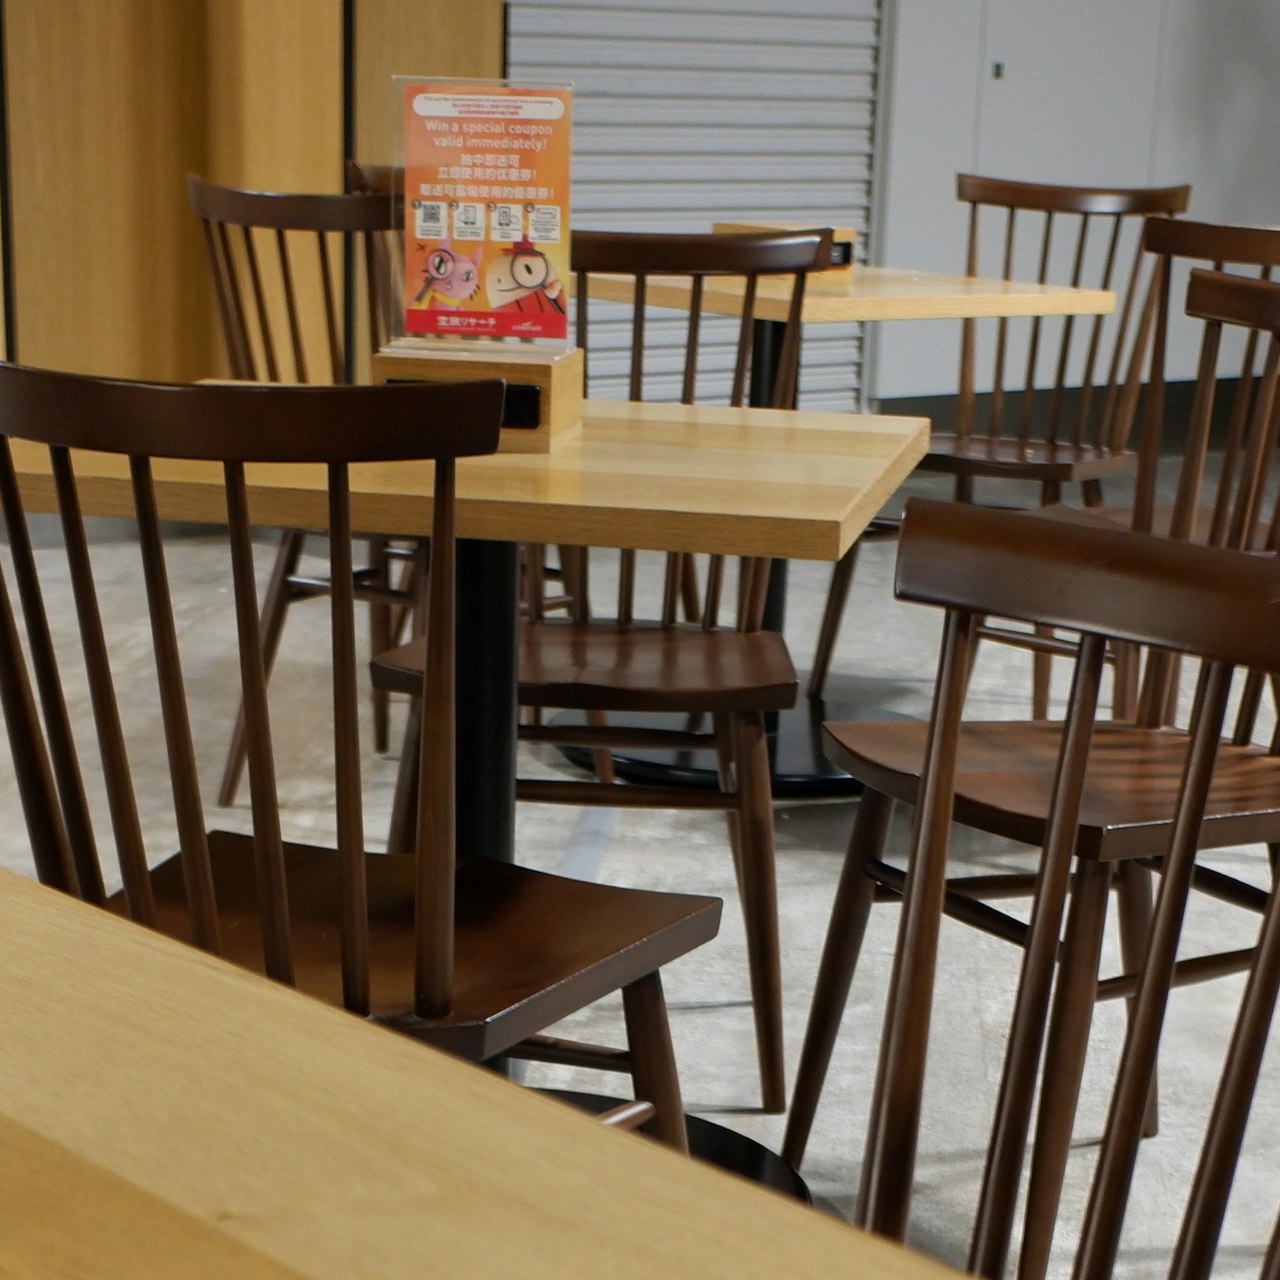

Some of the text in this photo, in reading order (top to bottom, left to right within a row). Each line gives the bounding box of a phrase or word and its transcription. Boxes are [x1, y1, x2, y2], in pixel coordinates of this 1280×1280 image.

[425, 120, 553, 138] Win a special coupon
[434, 136, 547, 152] valid immediately!
